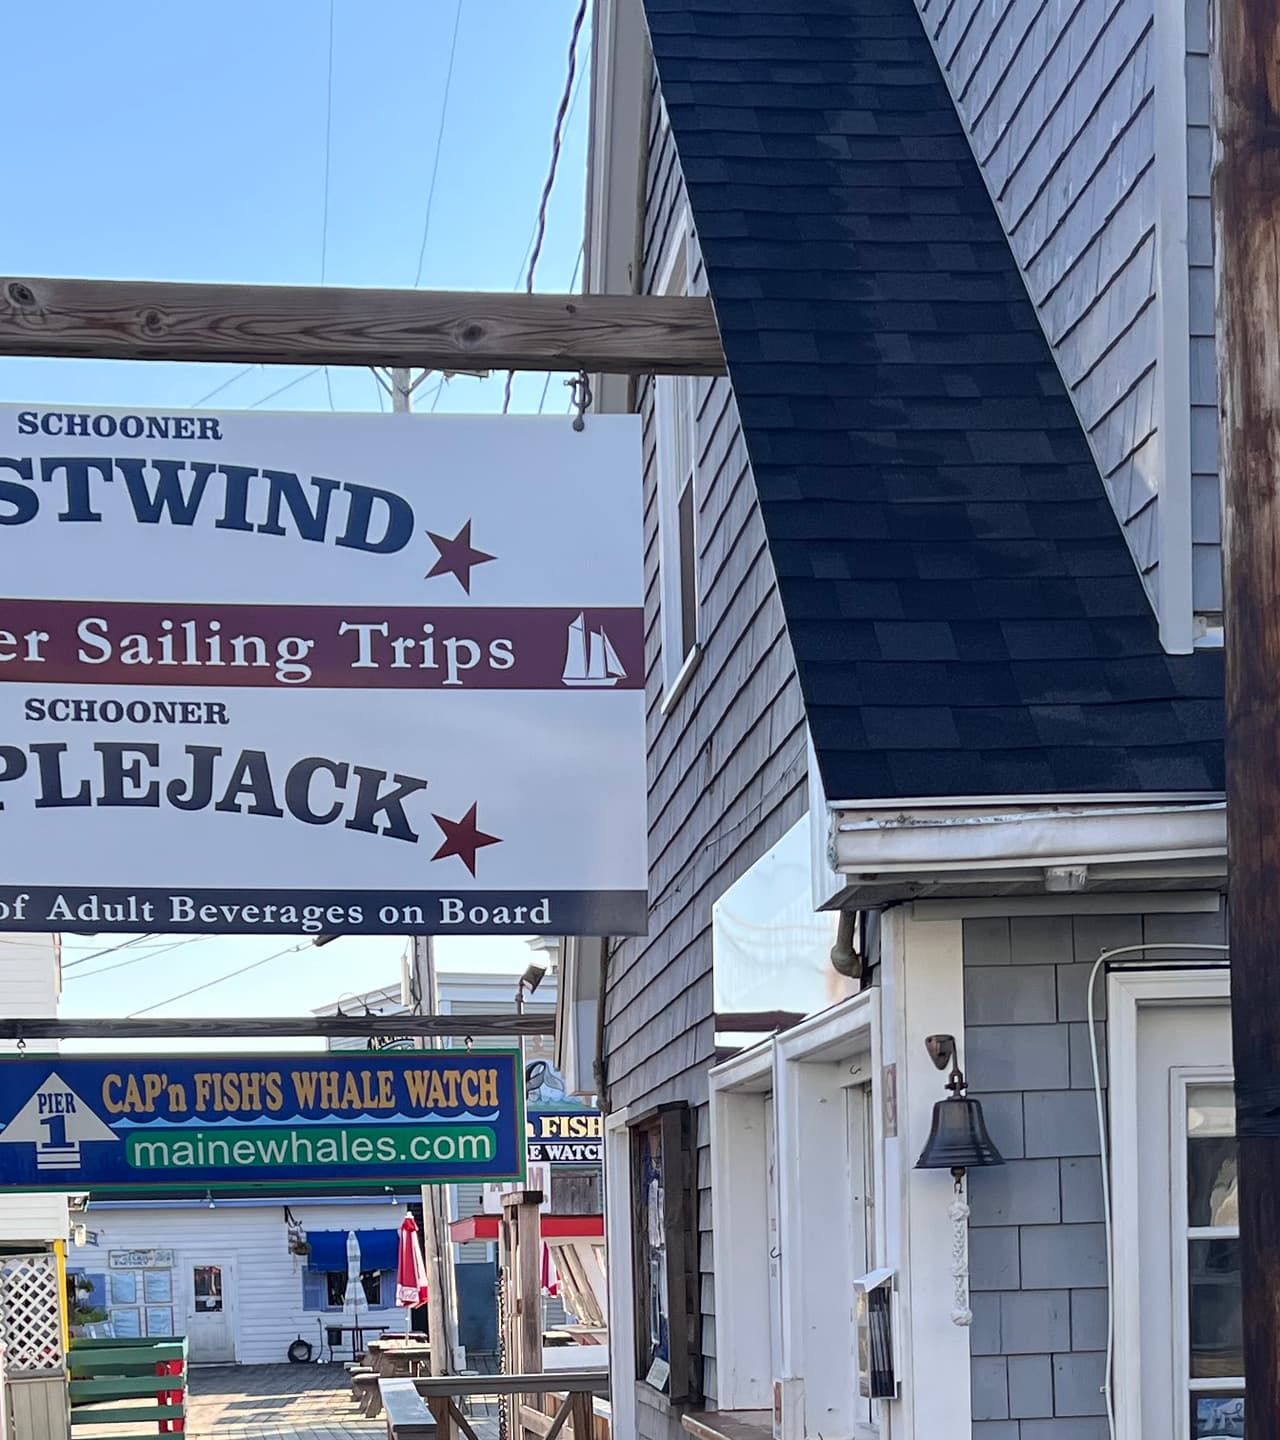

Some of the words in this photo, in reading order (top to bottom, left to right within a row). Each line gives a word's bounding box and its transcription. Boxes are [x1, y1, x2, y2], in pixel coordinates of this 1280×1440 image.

[17, 411, 223, 440] SCHOONER
[77, 617, 316, 684] Sailing
[338, 620, 517, 686] Trips
[24, 698, 231, 726] SCHOONER
[46, 894, 154, 922] Adult
[169, 896, 365, 932] Beverages
[378, 903, 426, 924] on
[440, 898, 552, 926] Board
[37, 1093, 77, 1114] PIER
[102, 1073, 187, 1113] CAP'n
[194, 1071, 284, 1112] FISH'S
[291, 1071, 396, 1108] WHALE
[403, 1069, 499, 1107] WATCH
[39, 1114, 75, 1149] 1
[133, 1132, 492, 1168] mainewhales.com
[545, 1145, 603, 1160] WATC
